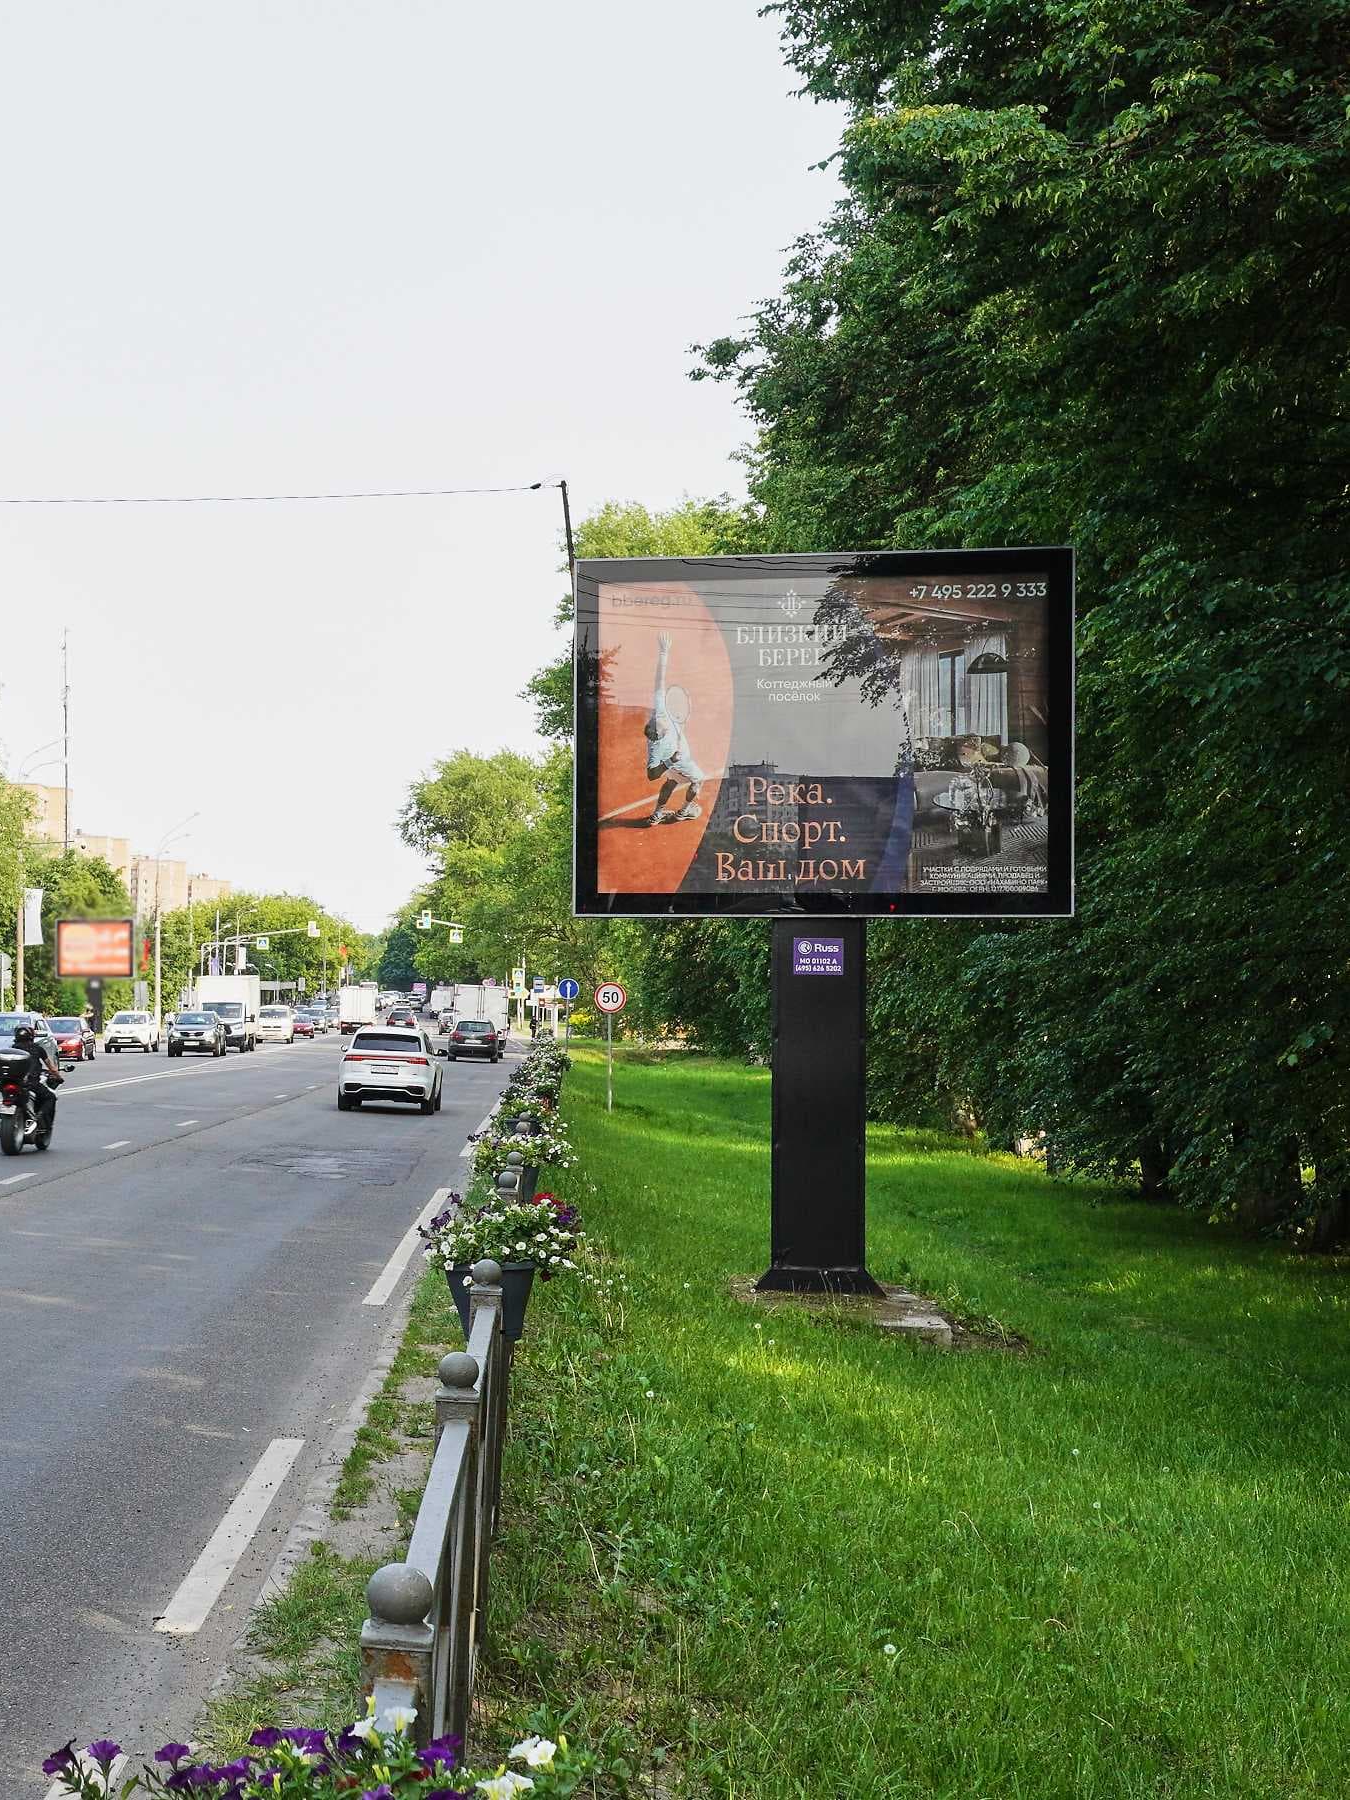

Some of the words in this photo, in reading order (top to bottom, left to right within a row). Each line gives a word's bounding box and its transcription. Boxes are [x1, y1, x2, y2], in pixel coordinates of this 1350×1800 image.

[909, 585, 927, 599] +7
[931, 584, 962, 599] 495
[966, 583, 997, 598] 222
[1001, 583, 1012, 597] 9
[1016, 582, 1047, 597] 333
[757, 679, 833, 691] Коттеджный
[746, 776, 833, 805] Река.
[733, 813, 846, 849] Спорт.
[715, 852, 787, 881] Ваш
[795, 859, 867, 885] дом
[814, 943, 839, 952] Russ
[602, 991, 619, 1004] 50
